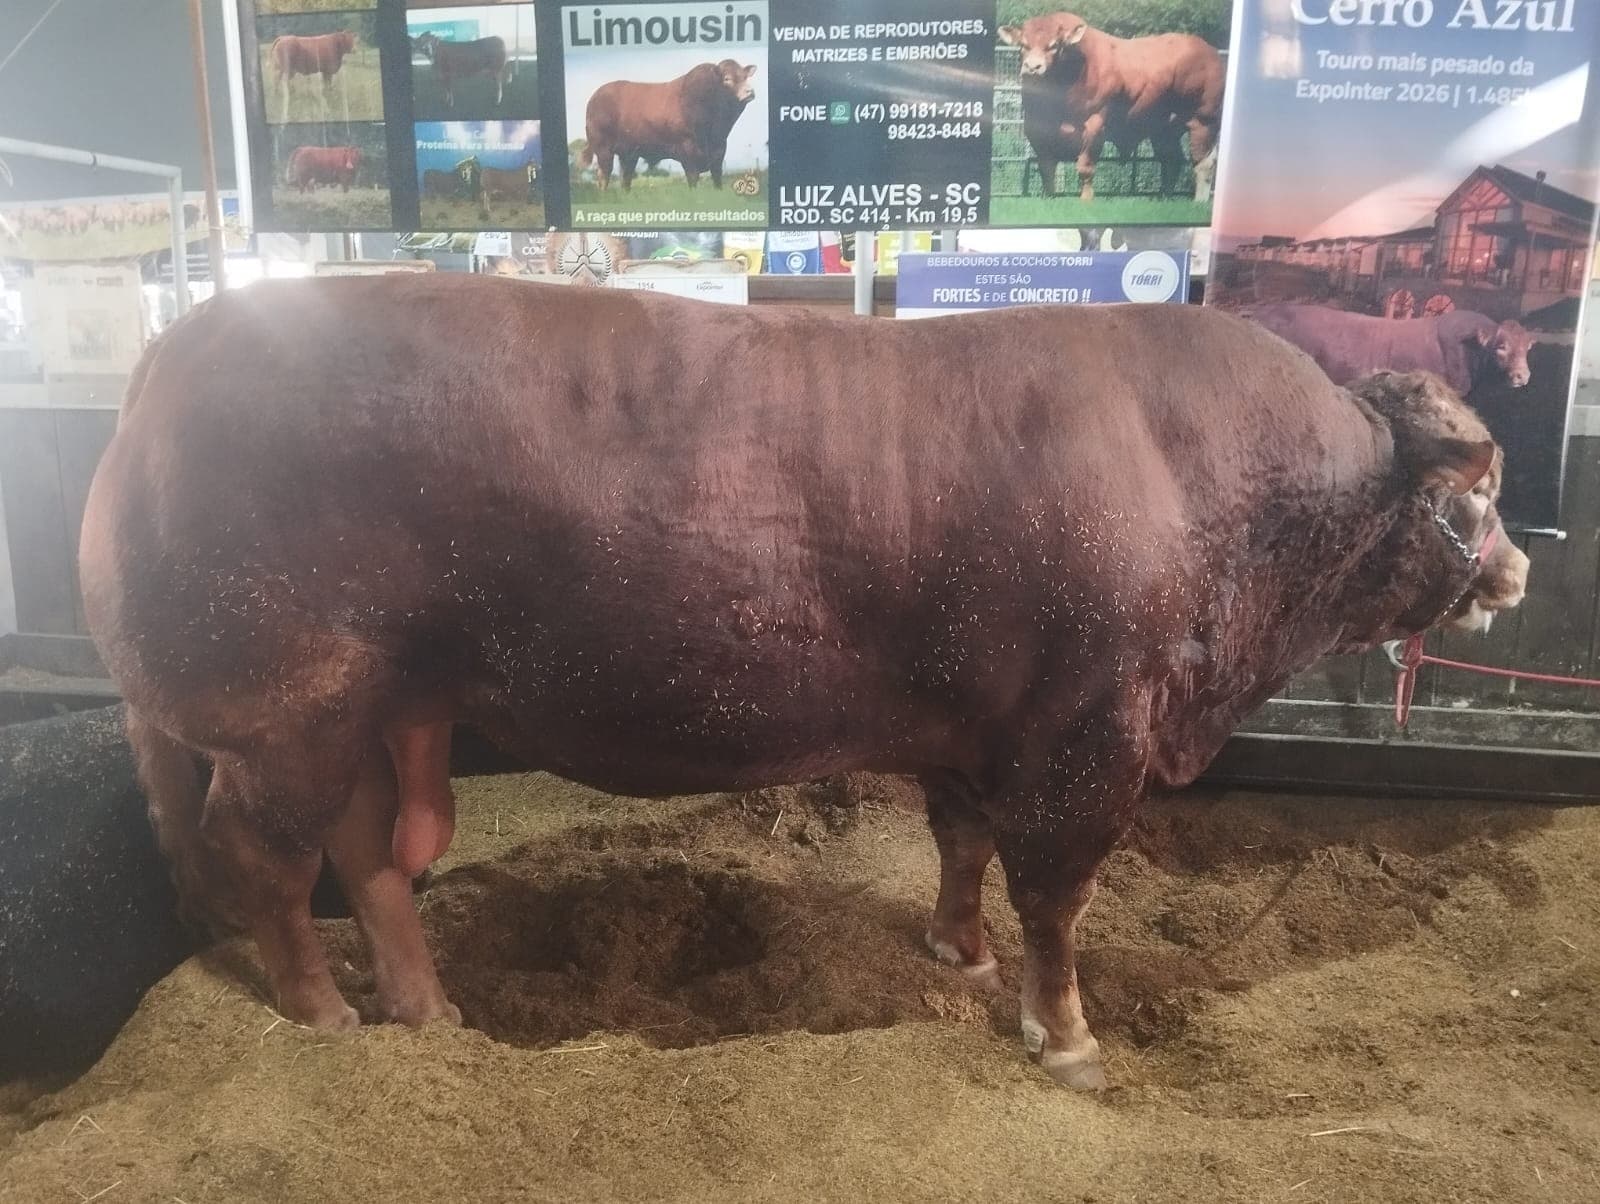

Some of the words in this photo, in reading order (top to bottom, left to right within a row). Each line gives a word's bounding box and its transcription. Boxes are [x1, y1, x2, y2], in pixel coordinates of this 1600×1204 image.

[569, 4, 762, 46] Limousin
[1446, 0, 1575, 32] Azul
[773, 26, 826, 41] VENDA
[829, 25, 850, 39] DE
[854, 19, 988, 39] REPRODUTORES,
[791, 47, 868, 63] MATRIZES
[871, 48, 882, 61] E
[1316, 50, 1373, 70] Touro
[1376, 52, 1426, 72] mais
[1431, 57, 1505, 77] pesado
[1509, 56, 1535, 77] da
[1396, 83, 1450, 103] 2026
[780, 105, 826, 121] FONE
[854, 103, 885, 123] (47)
[889, 101, 983, 119] 99181-7218
[888, 122, 982, 139] 98423-8484
[780, 185, 834, 207] LUIZ
[840, 184, 922, 206] ALVES
[946, 183, 981, 205] SC
[575, 210, 586, 222] A
[587, 211, 616, 225] raça
[618, 212, 643, 225] que
[645, 209, 692, 224] produz
[694, 208, 766, 222] resultados
[781, 209, 824, 225] ROD.
[830, 208, 855, 224] SC
[859, 208, 891, 224] 414
[906, 207, 935, 223] Km
[942, 207, 978, 225] 19,5
[927, 256, 1000, 266] BEBEDOUROS
[1001, 256, 1010, 266] &
[1011, 256, 1058, 266] COCHOS
[1060, 256, 1093, 266] TORRI
[975, 273, 1007, 284] ESTES
[1009, 272, 1032, 284] SÃO
[1131, 274, 1163, 286] TORRI
[933, 288, 981, 303] FORTES
[983, 292, 990, 302] E
[992, 292, 1007, 302] DE
[1009, 288, 1078, 304] CONCRETO
